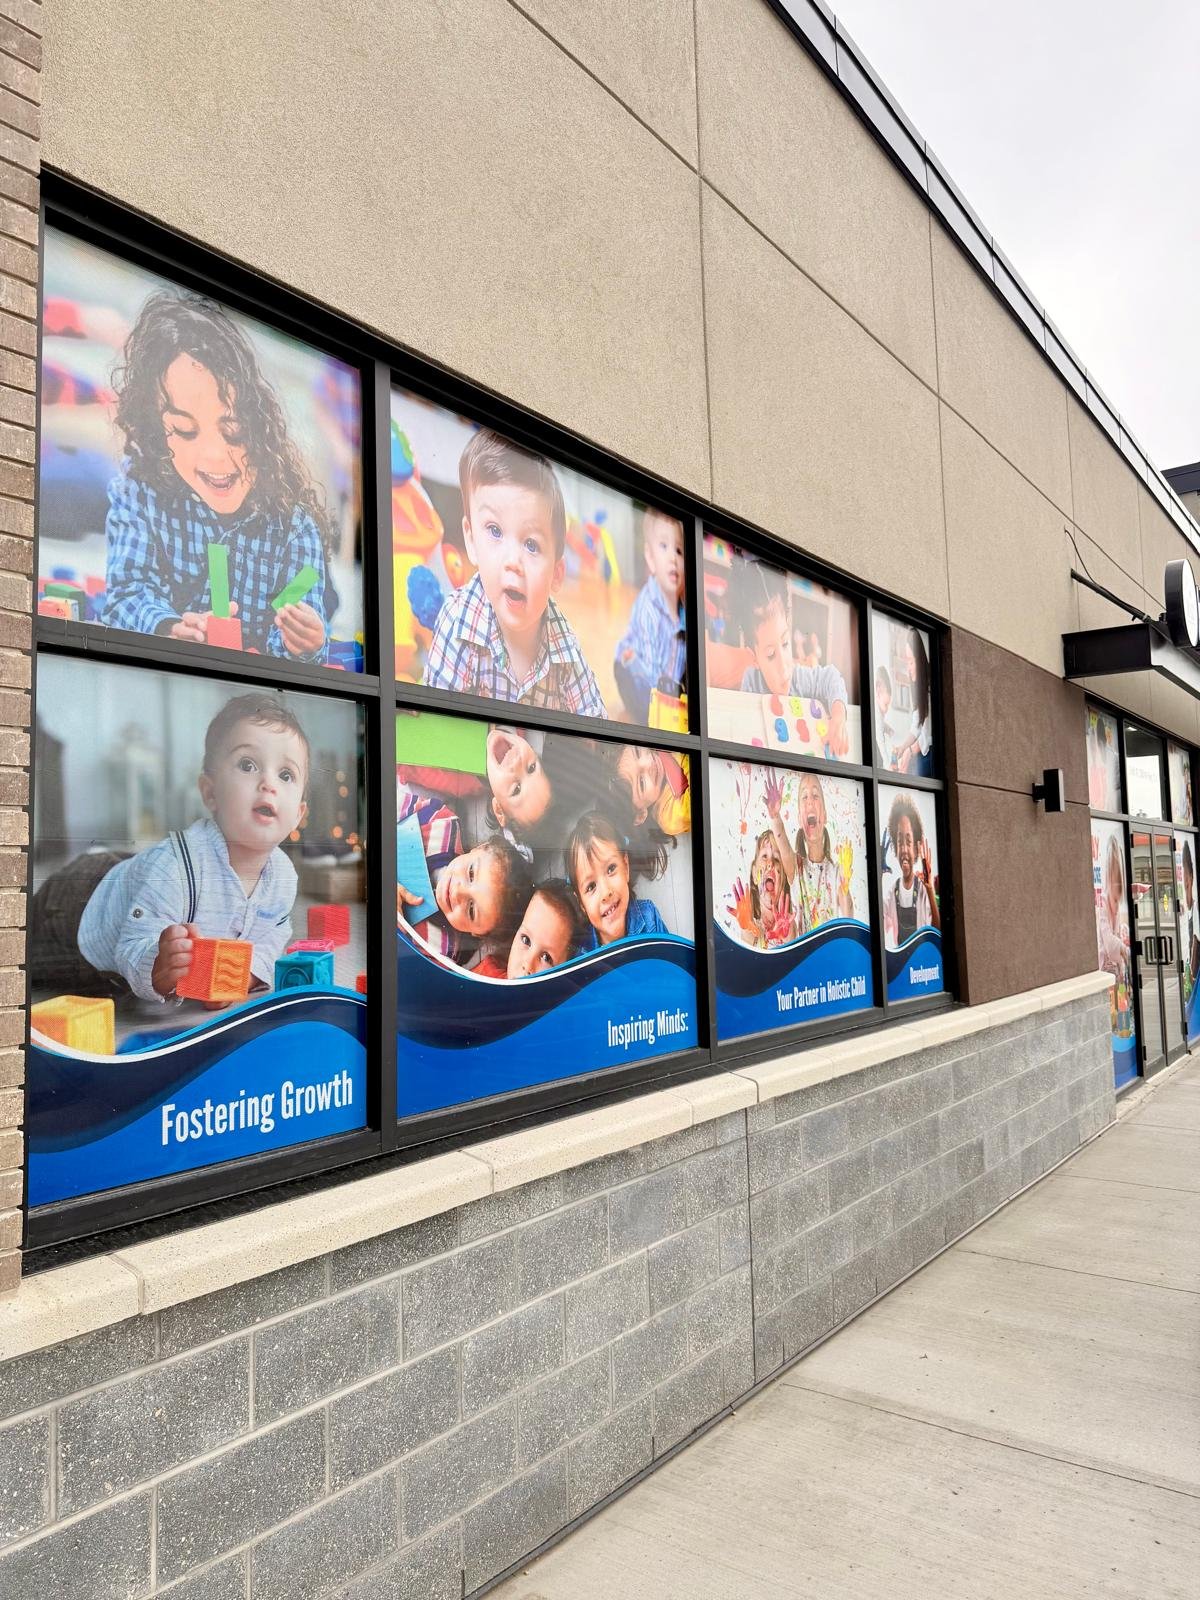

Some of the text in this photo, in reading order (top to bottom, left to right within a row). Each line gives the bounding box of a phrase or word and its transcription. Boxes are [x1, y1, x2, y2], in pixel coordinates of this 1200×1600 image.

[776, 975, 866, 1012] Your Partner in Holistic Child
[909, 964, 940, 986] Development
[607, 1008, 689, 1050] Inspiring Minds:
[162, 1070, 353, 1146] Fostering Growth
